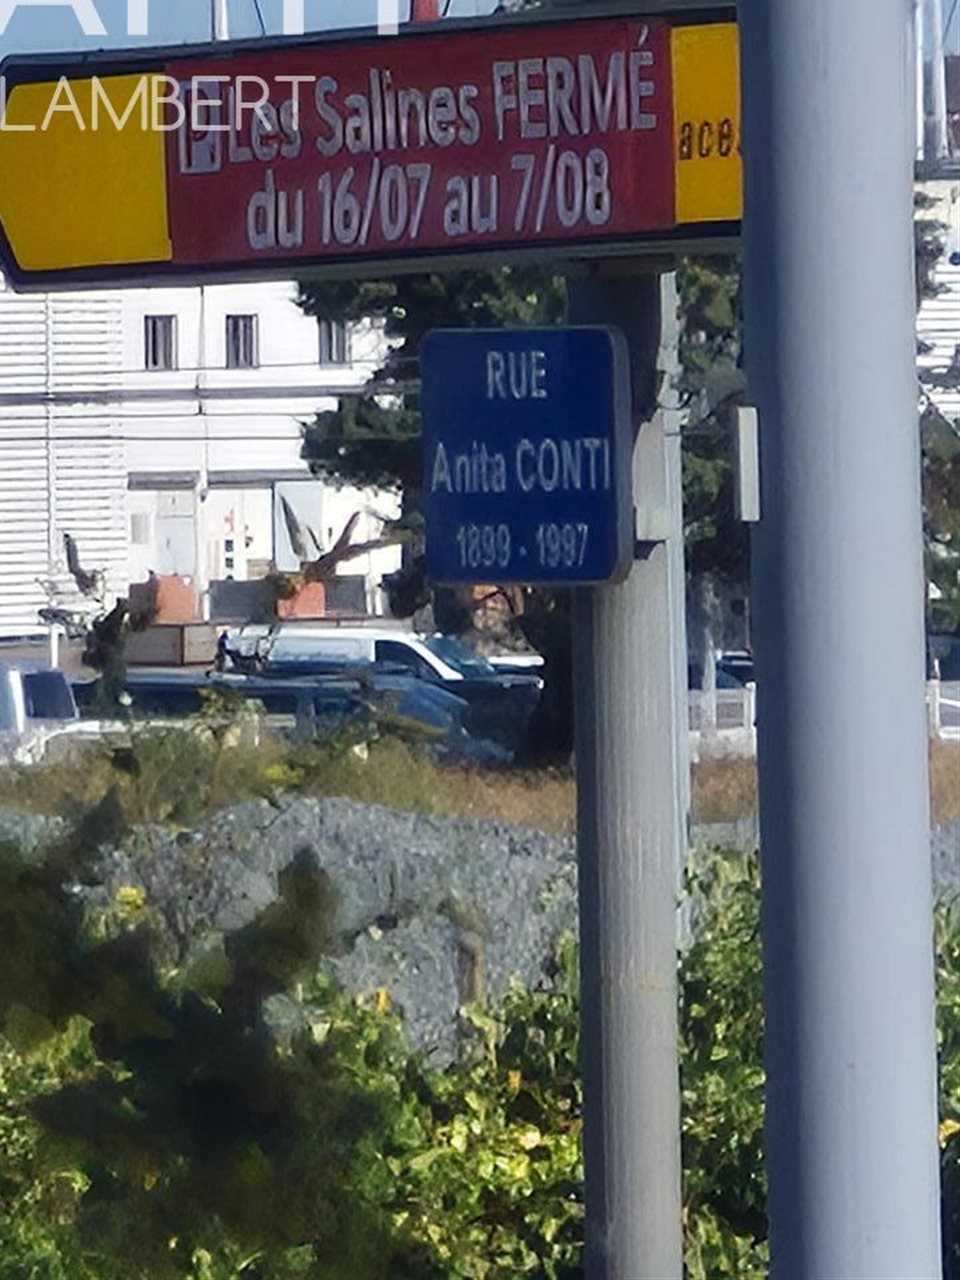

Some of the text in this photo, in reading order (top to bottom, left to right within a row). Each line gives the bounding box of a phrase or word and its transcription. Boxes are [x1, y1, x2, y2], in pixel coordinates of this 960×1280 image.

[228, 85, 302, 162] Les
[315, 68, 480, 157] Salines
[492, 25, 657, 141] FERMÉ
[247, 144, 611, 251] du 16/07 au 7/08
[487, 350, 547, 399] RUE
[431, 437, 610, 493] Anita CONTI
[456, 523, 511, 567] 1899
[536, 522, 589, 567] 1997
